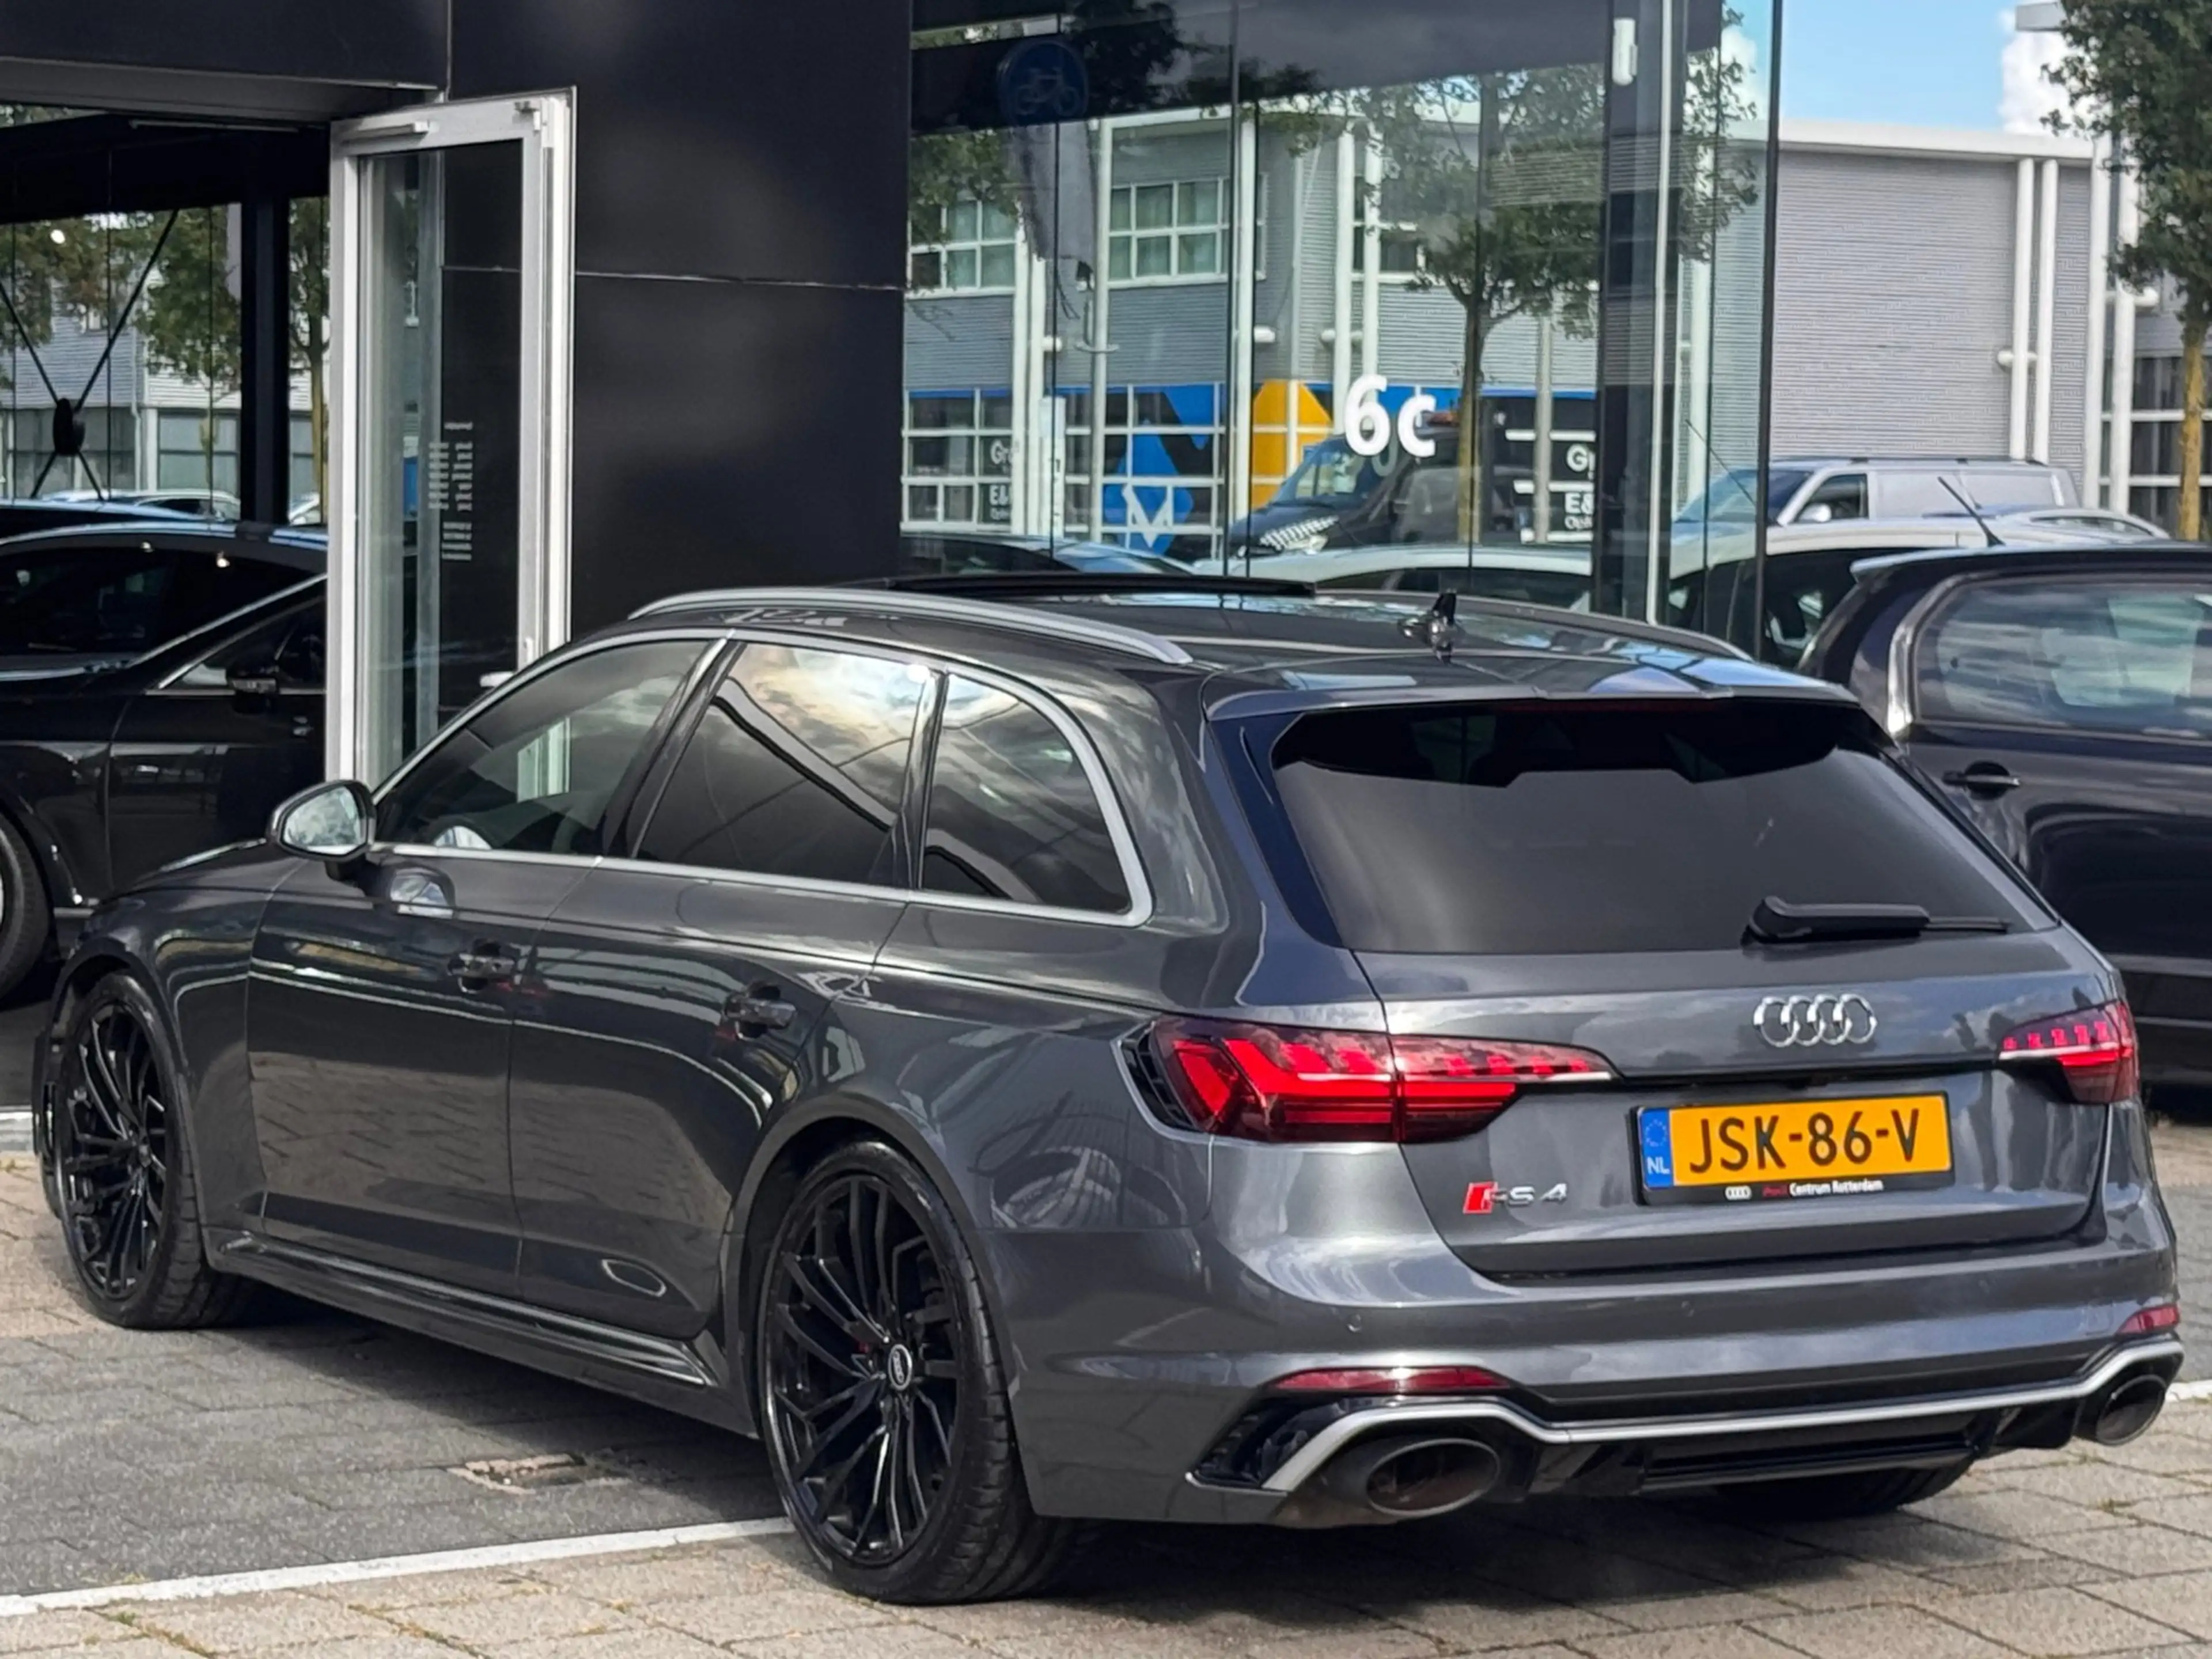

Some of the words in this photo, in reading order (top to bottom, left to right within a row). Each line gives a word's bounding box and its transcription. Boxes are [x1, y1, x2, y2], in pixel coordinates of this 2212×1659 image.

[1343, 373, 1437, 457] 6c
[1689, 1108, 1919, 1174] JSK-86-V
[1646, 1156, 1671, 1175] NL
[1789, 1182, 1831, 1197] Centrum
[1832, 1178, 1884, 1194] Rotterdam
